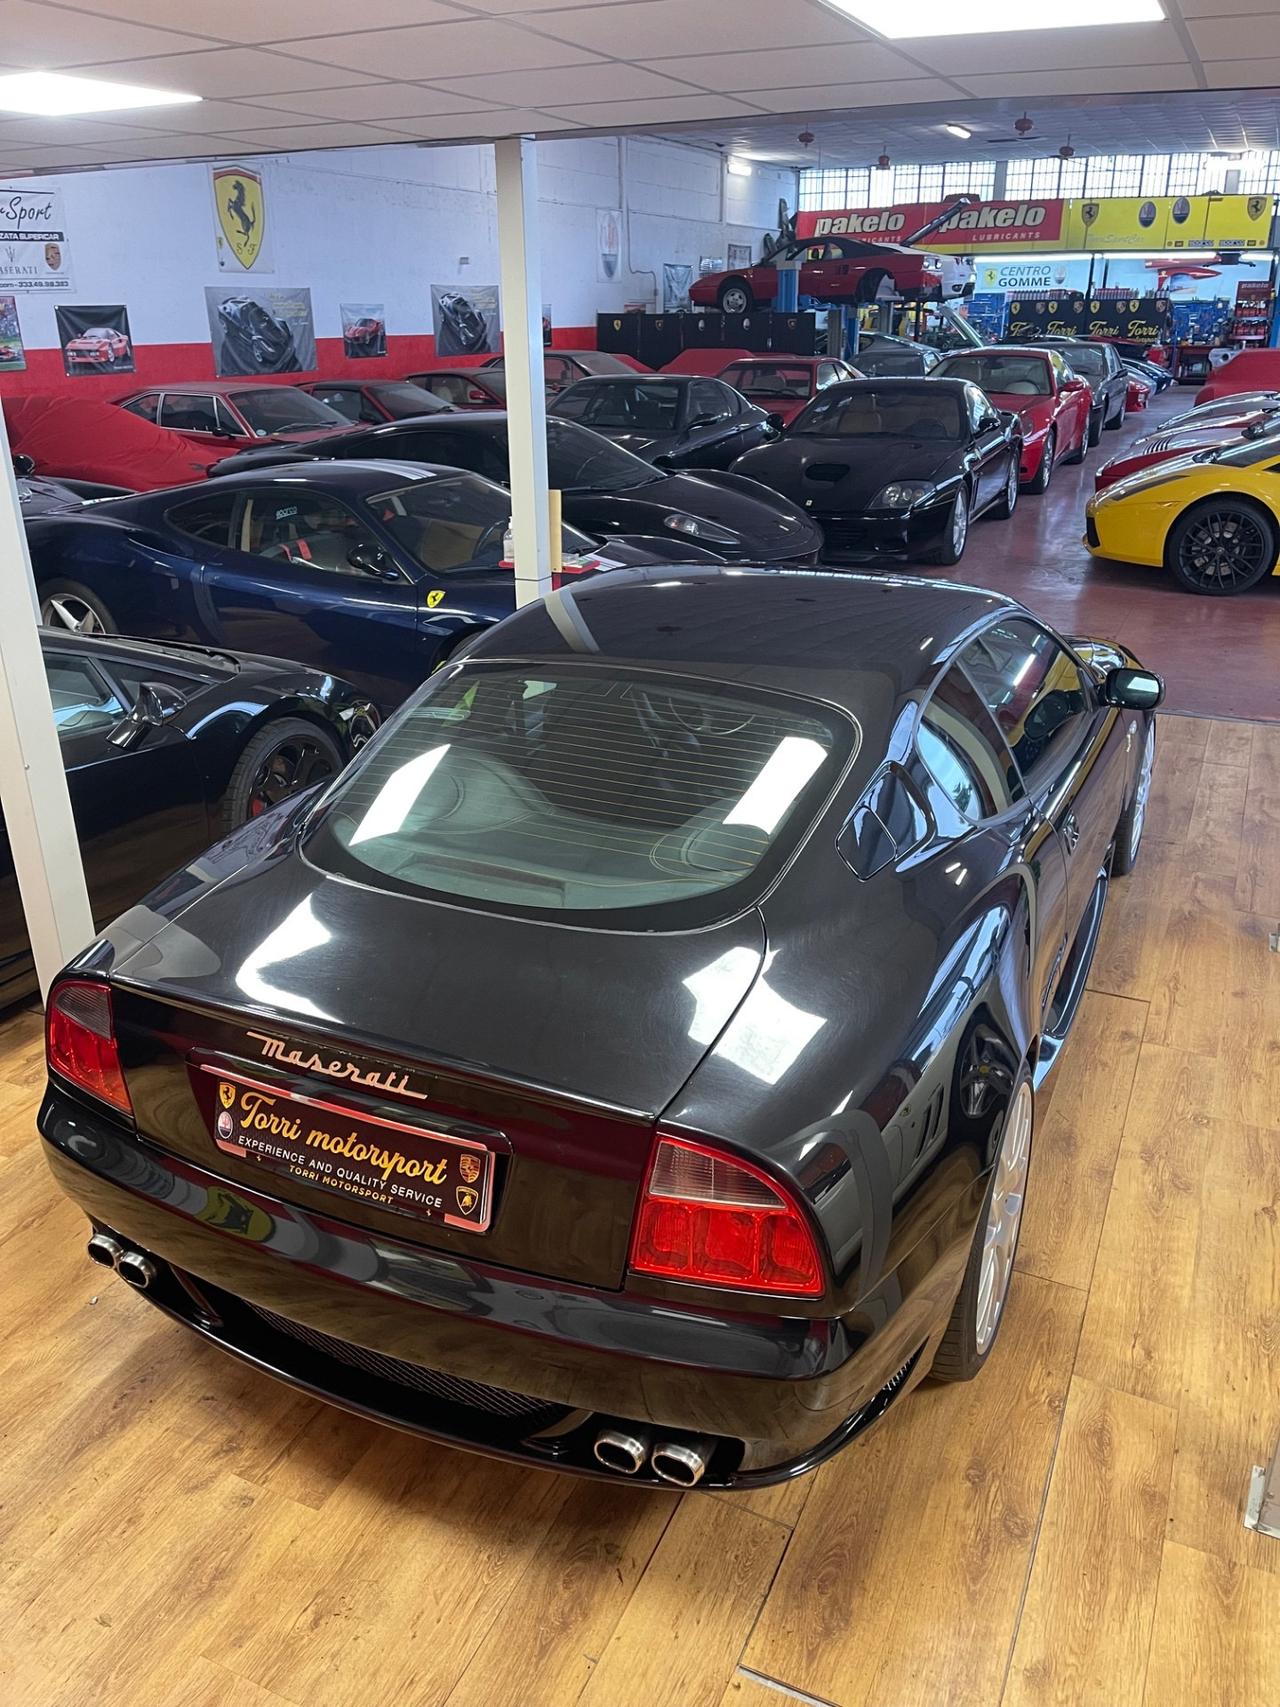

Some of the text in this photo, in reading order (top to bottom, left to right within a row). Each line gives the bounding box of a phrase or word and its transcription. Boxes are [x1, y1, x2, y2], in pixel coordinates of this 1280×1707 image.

[814, 211, 905, 238] pakelo
[19, 233, 60, 241] SUPERCAR
[972, 231, 1041, 241] LUBRICANTS
[1000, 265, 1051, 277] CENTRO
[998, 277, 1051, 288] GOMME
[1089, 320, 1120, 336] Torri
[1127, 319, 1159, 337] Torri
[246, 1031, 428, 1100] Maserati
[240, 1091, 448, 1185] Torri motorsport
[238, 1135, 443, 1208] EXPERIENCE AND QUALITY SERVICE
[289, 1165, 395, 1205] TORRI MOTORSPORT
